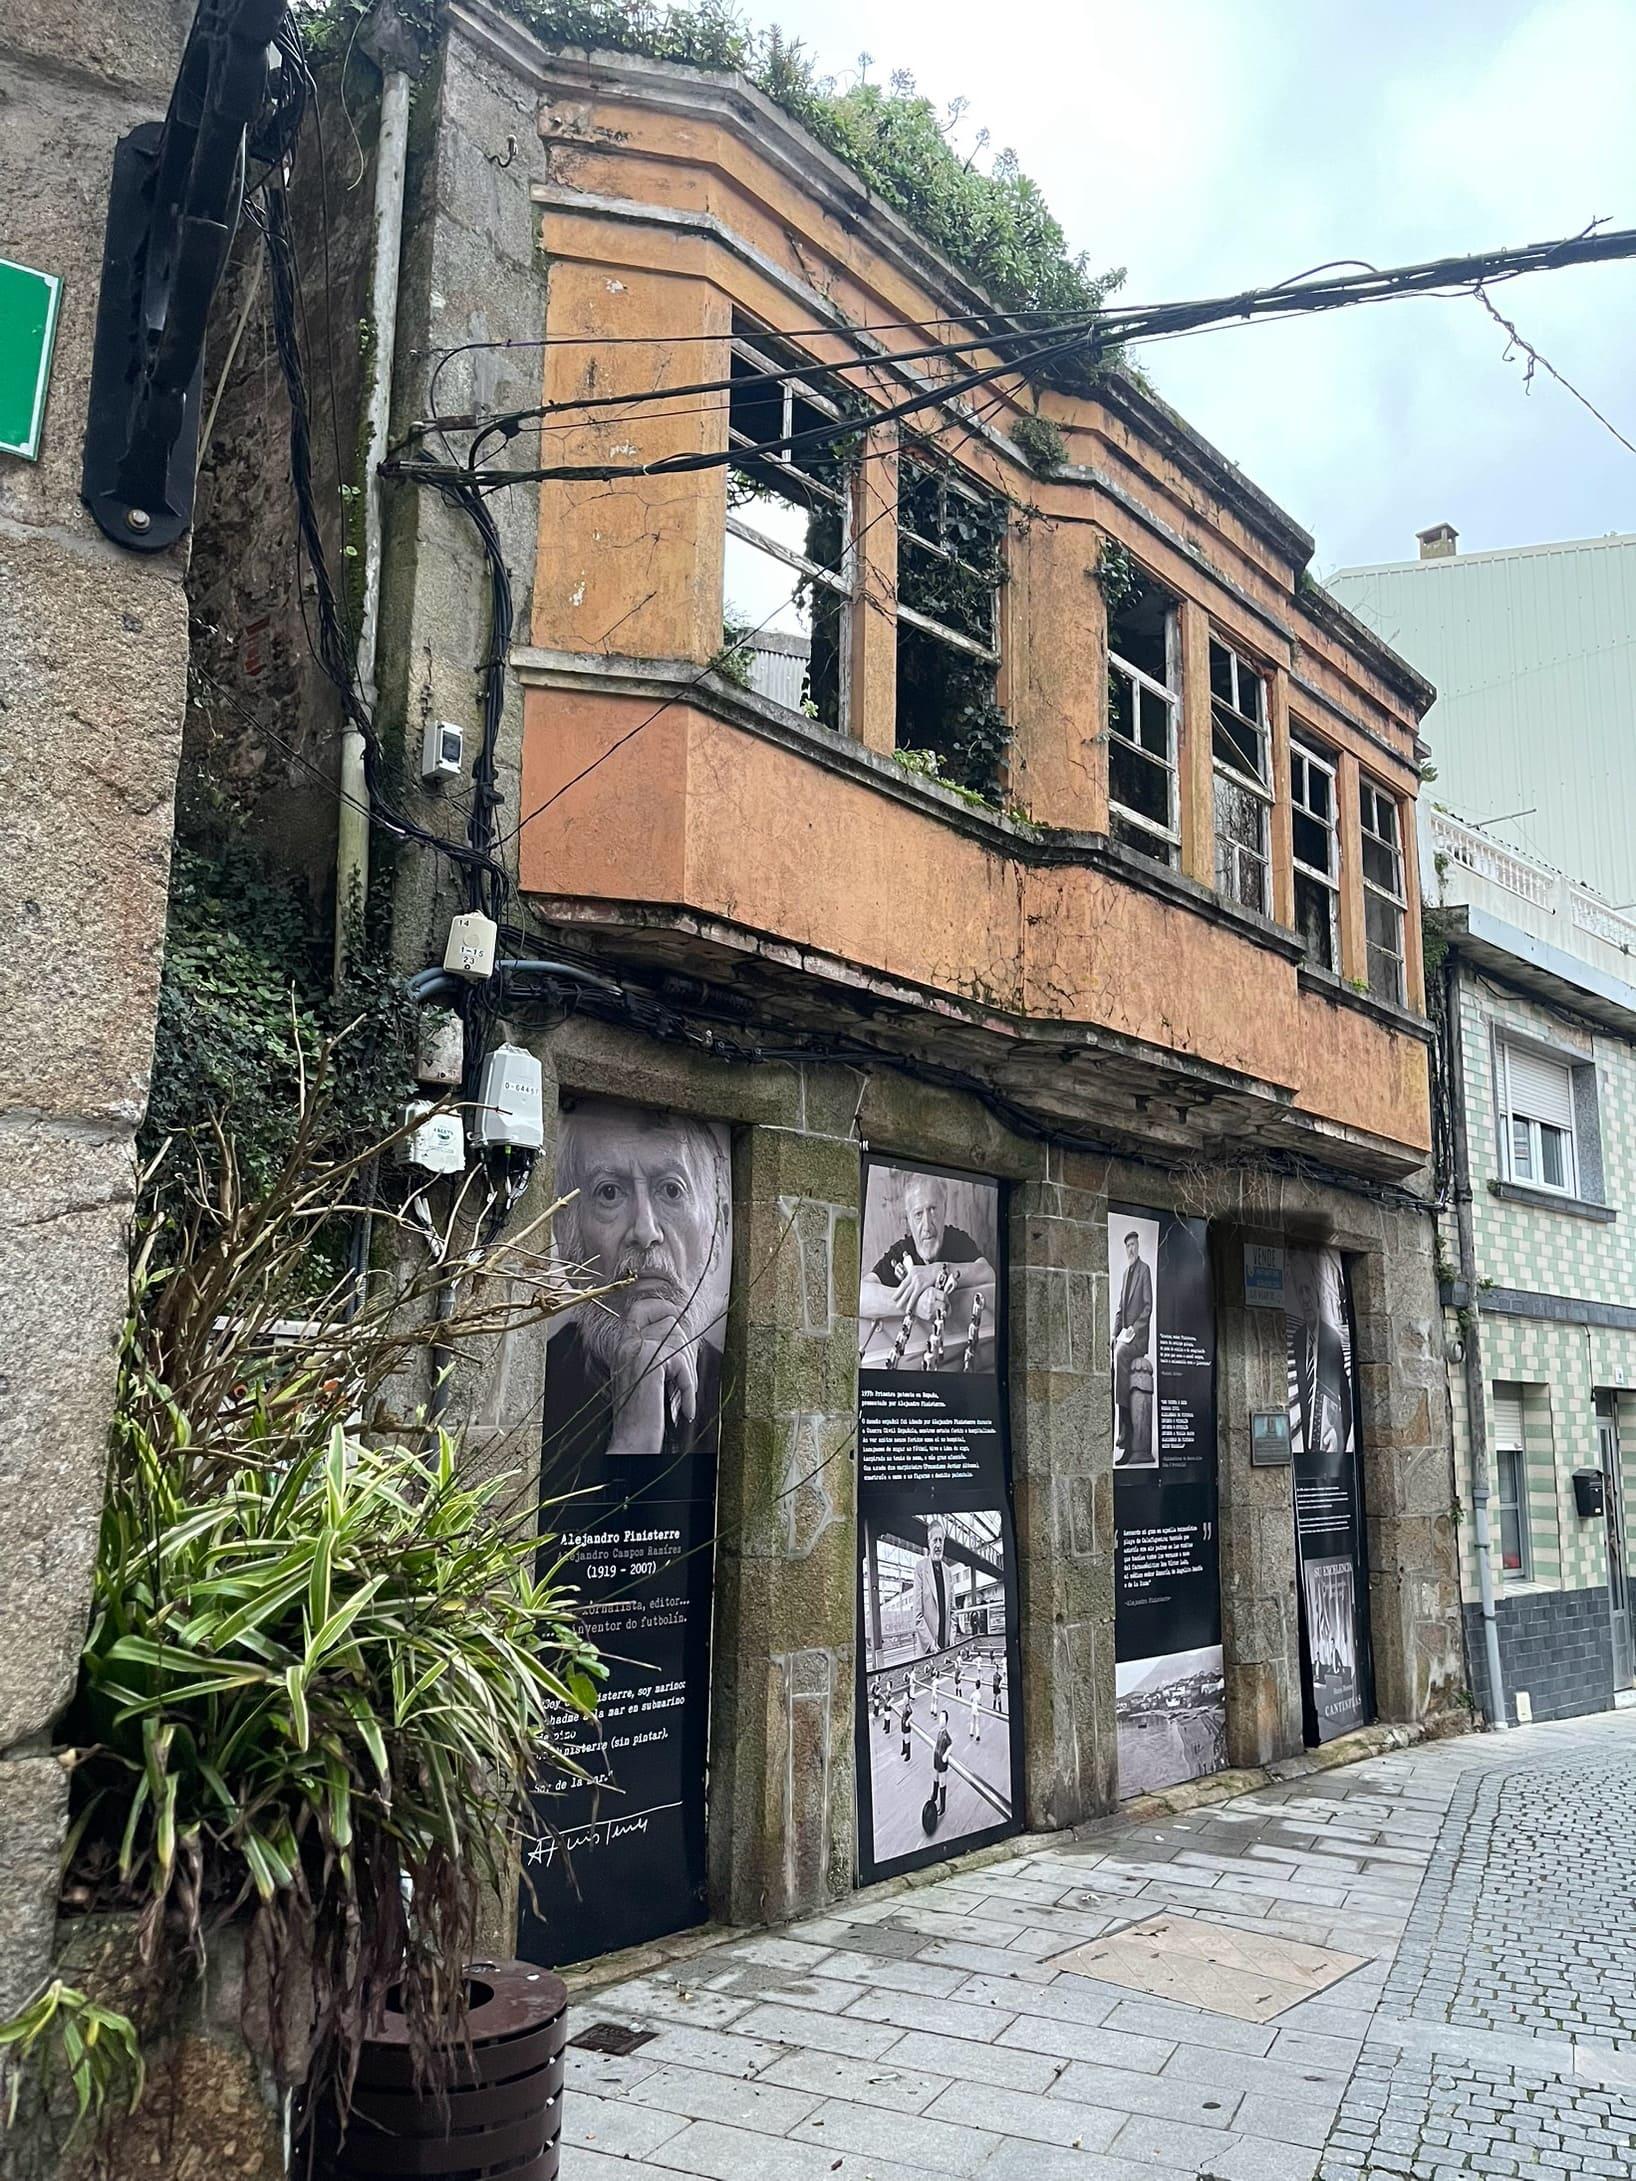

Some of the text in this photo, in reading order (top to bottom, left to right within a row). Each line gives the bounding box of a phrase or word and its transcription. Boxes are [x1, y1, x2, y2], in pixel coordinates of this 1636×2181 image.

[560, 1529, 681, 1547] Alejandro Finisterre
[612, 1547, 645, 1559] Campos
[586, 1564, 617, 1579] (1919
[630, 1560, 657, 1575] 2007)
[625, 1618, 638, 1630] do
[640, 1611, 688, 1628] futbolín.
[637, 1686, 653, 1697] soy
[608, 1706, 626, 1717] mar
[627, 1704, 639, 1714] en
[641, 1695, 686, 1711] submarino
[611, 1735, 630, 1749] (sin
[555, 1779, 567, 1791] de
[570, 1777, 583, 1788] la
